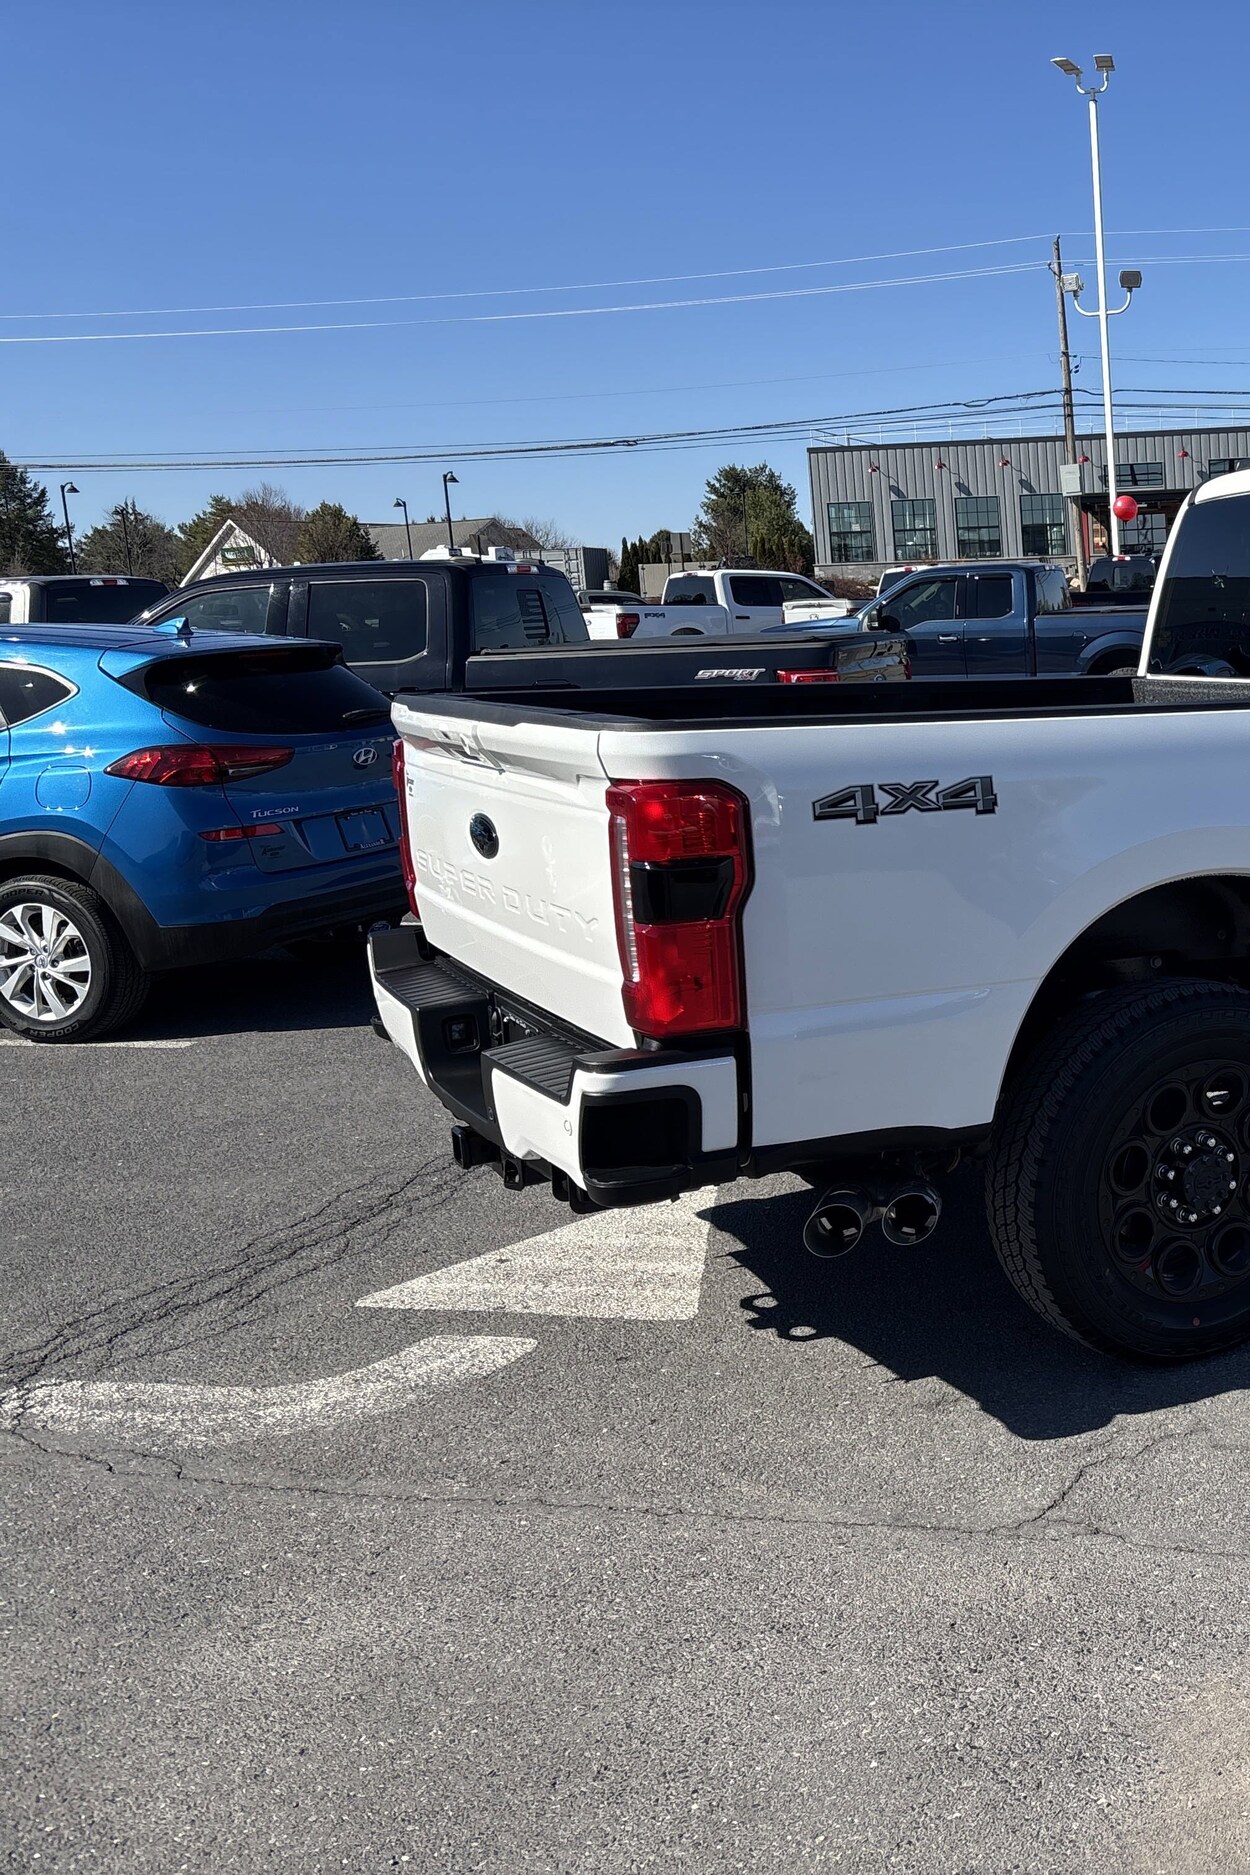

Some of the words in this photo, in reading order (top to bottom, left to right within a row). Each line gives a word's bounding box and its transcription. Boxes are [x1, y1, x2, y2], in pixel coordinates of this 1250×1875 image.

[694, 668, 766, 680] SPORT
[0, 888, 45, 902] OOPER
[416, 848, 497, 905] SUPER
[502, 885, 599, 943] DUTY
[28, 1021, 80, 1038] COOPER
